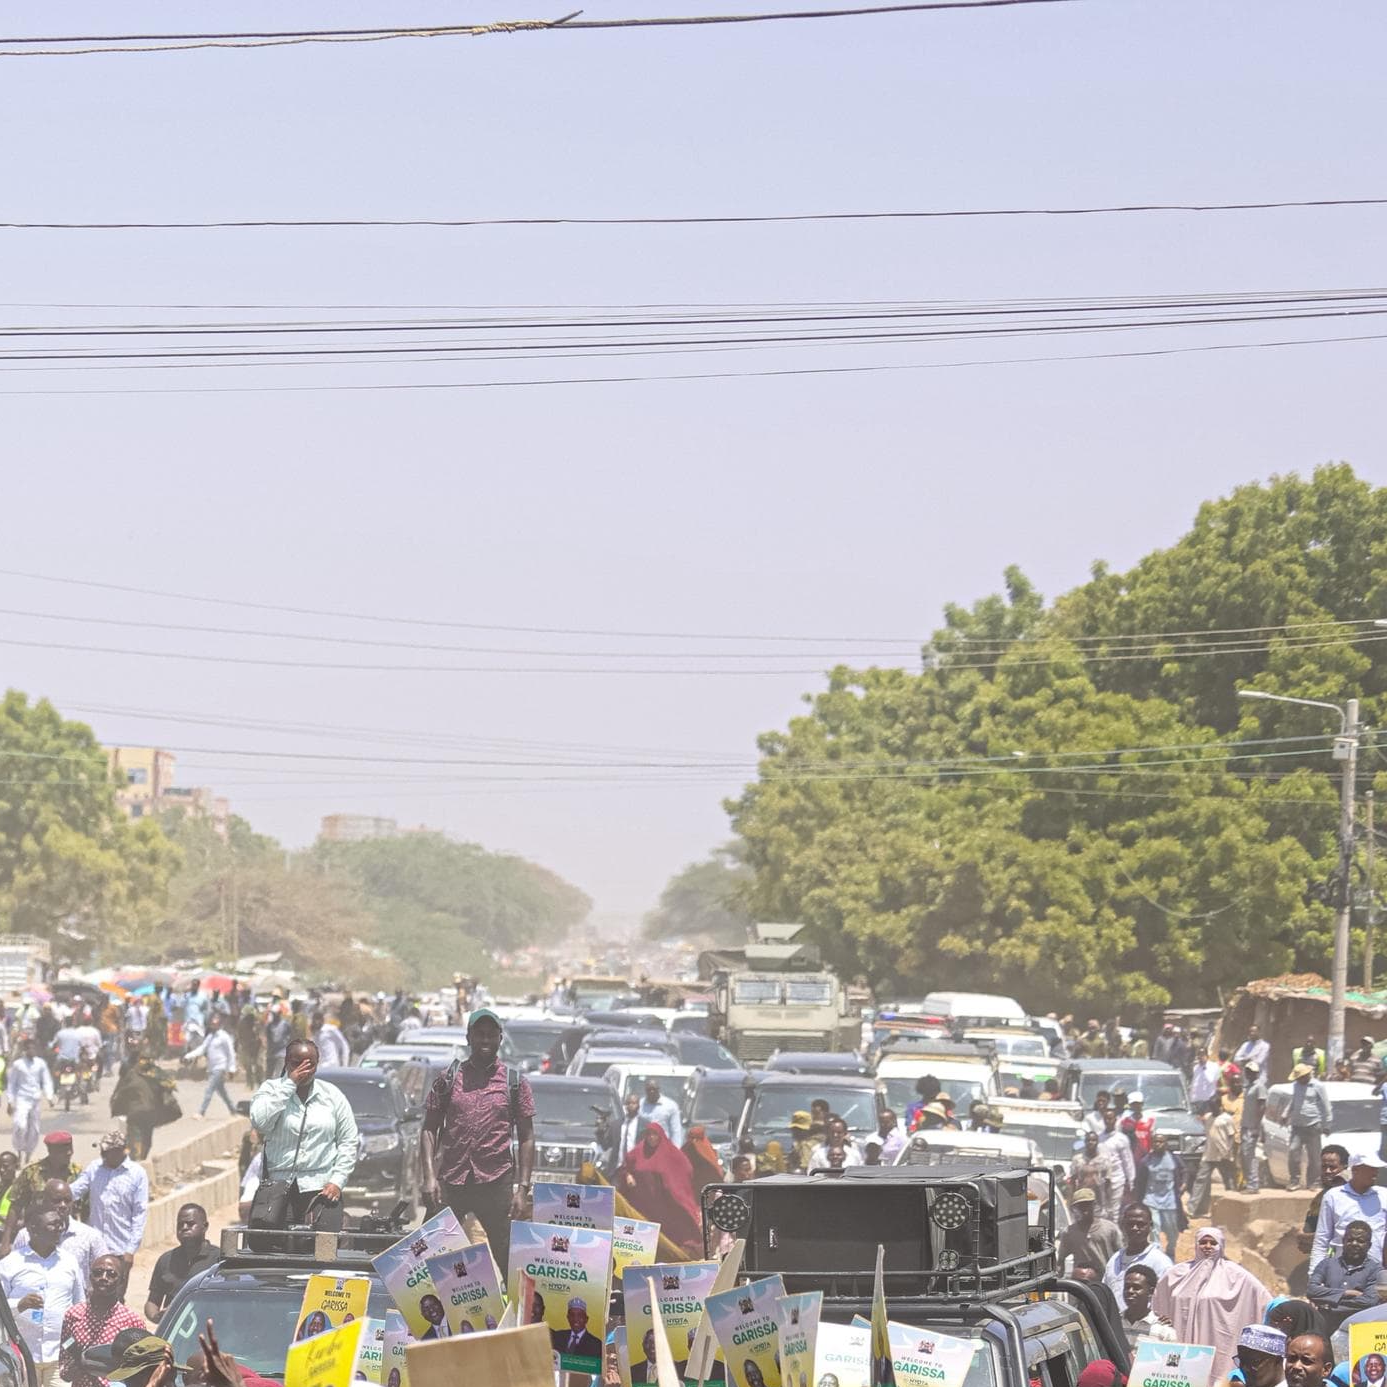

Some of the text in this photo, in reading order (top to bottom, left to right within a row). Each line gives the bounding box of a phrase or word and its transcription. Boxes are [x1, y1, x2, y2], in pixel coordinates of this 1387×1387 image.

[554, 1214, 583, 1222] WELCOME
[614, 1241, 644, 1252] ARISSA
[534, 1257, 570, 1267] WELCOME
[526, 1264, 588, 1283] GARISSA
[451, 1287, 489, 1306] GARISSA
[321, 1299, 348, 1312] GARISSA
[734, 1318, 761, 1331] WELCOME
[732, 1321, 779, 1345] GARISSA
[783, 1340, 807, 1356] GARISSA
[900, 1356, 933, 1366] WELCOME
[892, 1360, 946, 1380] GARISSA
